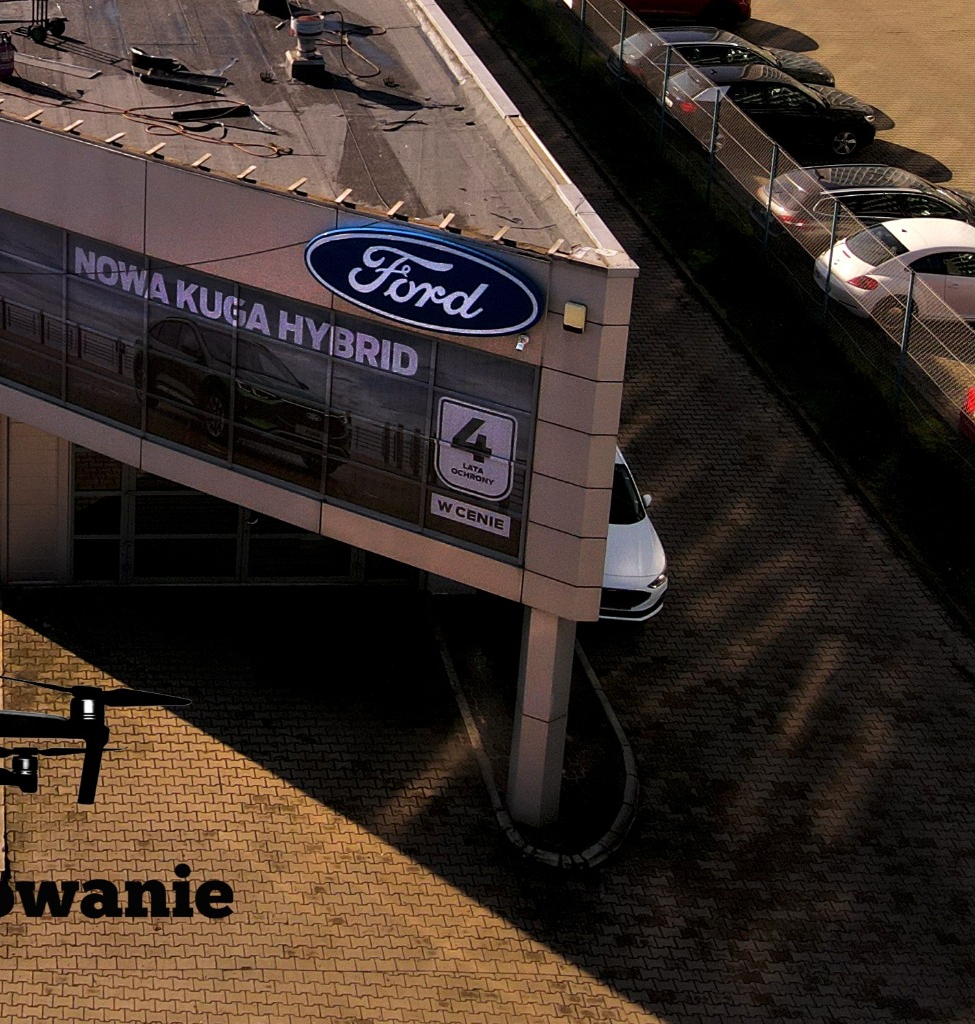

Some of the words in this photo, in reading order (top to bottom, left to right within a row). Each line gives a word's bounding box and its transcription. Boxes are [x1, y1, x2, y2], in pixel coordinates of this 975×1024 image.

[348, 245, 489, 319] Ford
[74, 246, 170, 305] NOWA
[176, 279, 271, 337] KUGA
[278, 309, 419, 378] HYBRID
[450, 417, 492, 463] 4
[451, 467, 495, 486] OCHRONY
[462, 462, 484, 475] LATA
[437, 499, 454, 514] W
[455, 506, 505, 530] CENIE
